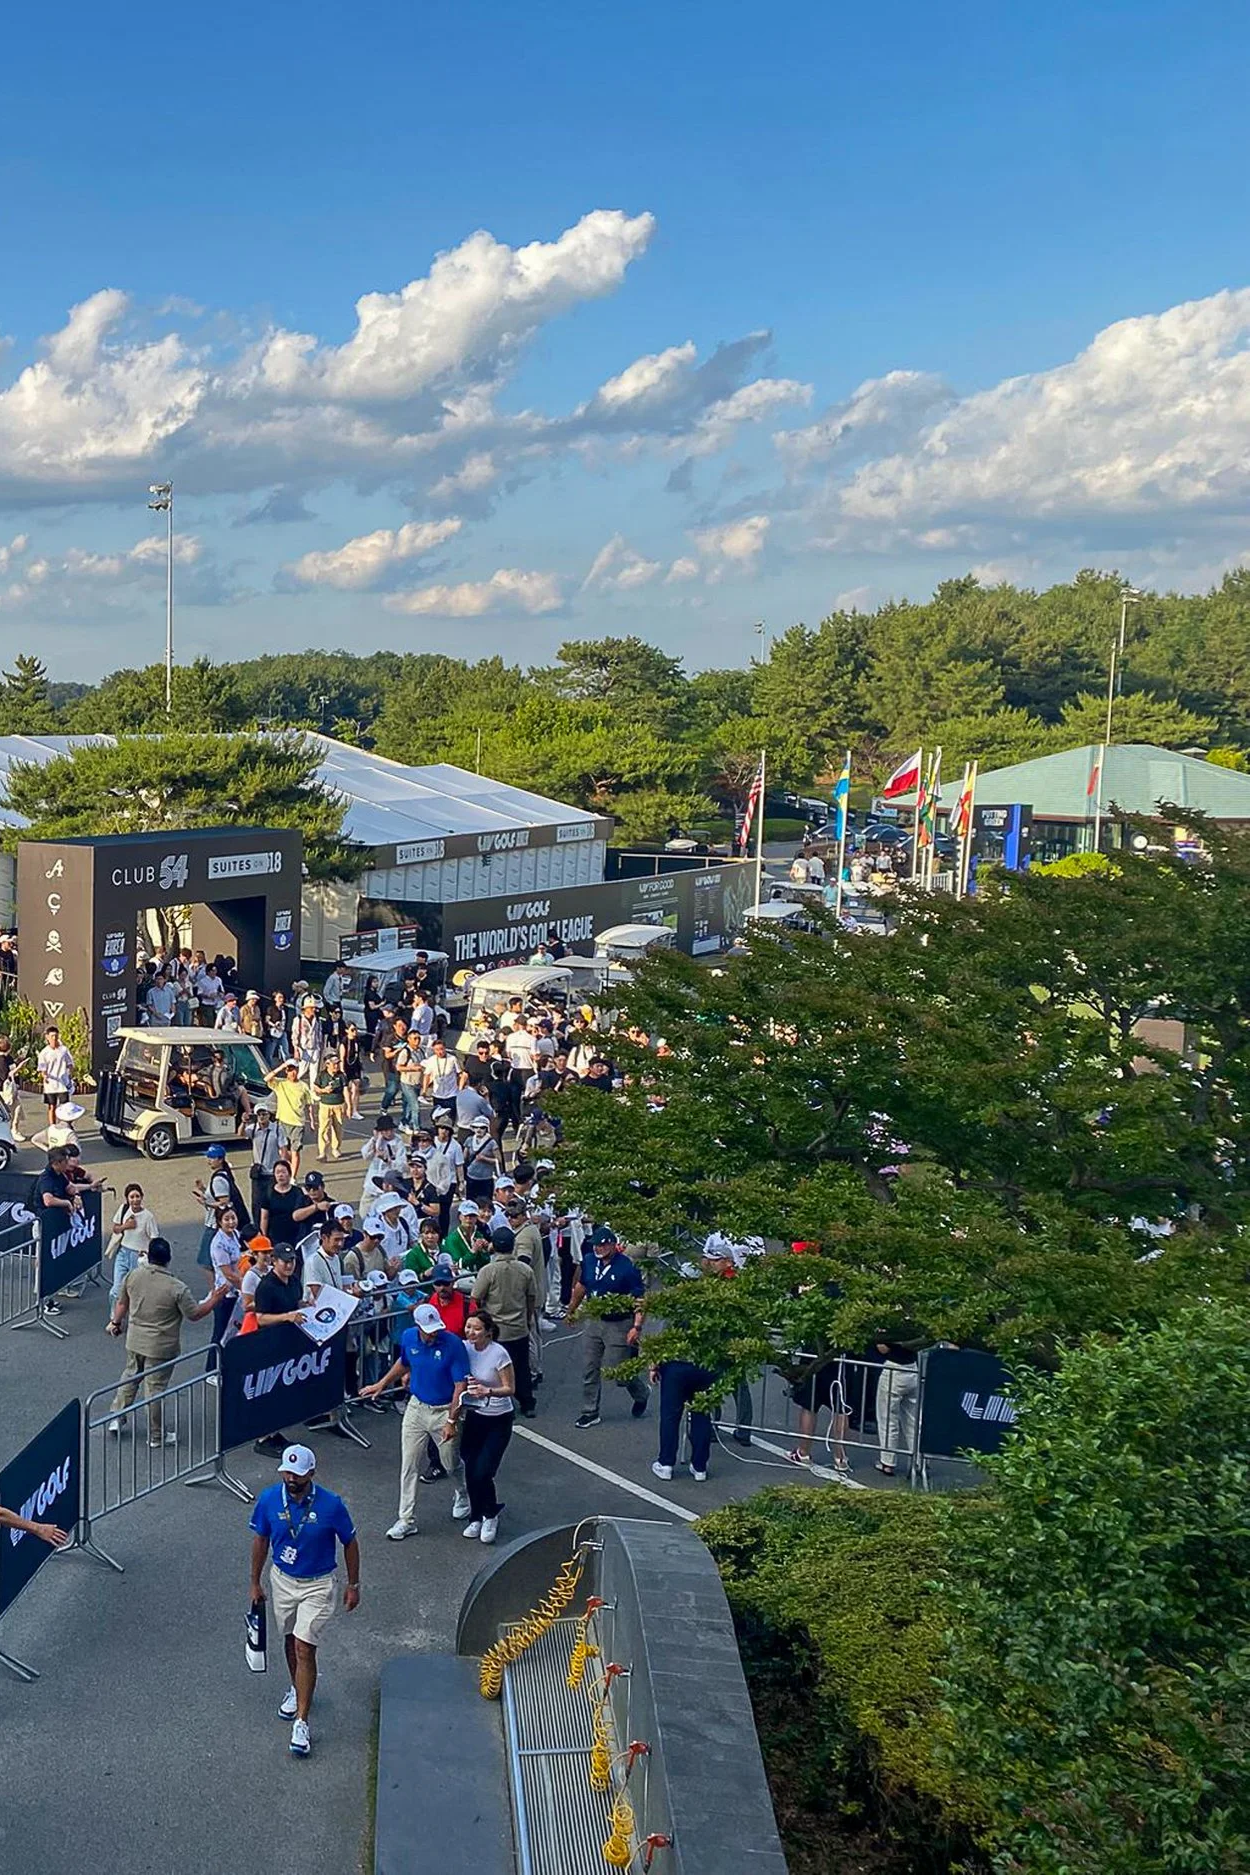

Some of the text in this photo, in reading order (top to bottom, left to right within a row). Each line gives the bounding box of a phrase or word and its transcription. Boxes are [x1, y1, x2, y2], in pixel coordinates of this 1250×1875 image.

[213, 859, 251, 873] SUITES
[268, 851, 282, 873] 18
[399, 848, 426, 860] SUITES
[111, 854, 189, 890] CLUB 54
[525, 900, 550, 918] GOLF
[454, 934, 476, 961] THE
[479, 925, 528, 955] WORLD'S
[51, 1229, 72, 1260] LIV
[243, 1346, 331, 1400] LIV GOLF
[36, 1456, 70, 1516] GOLF
